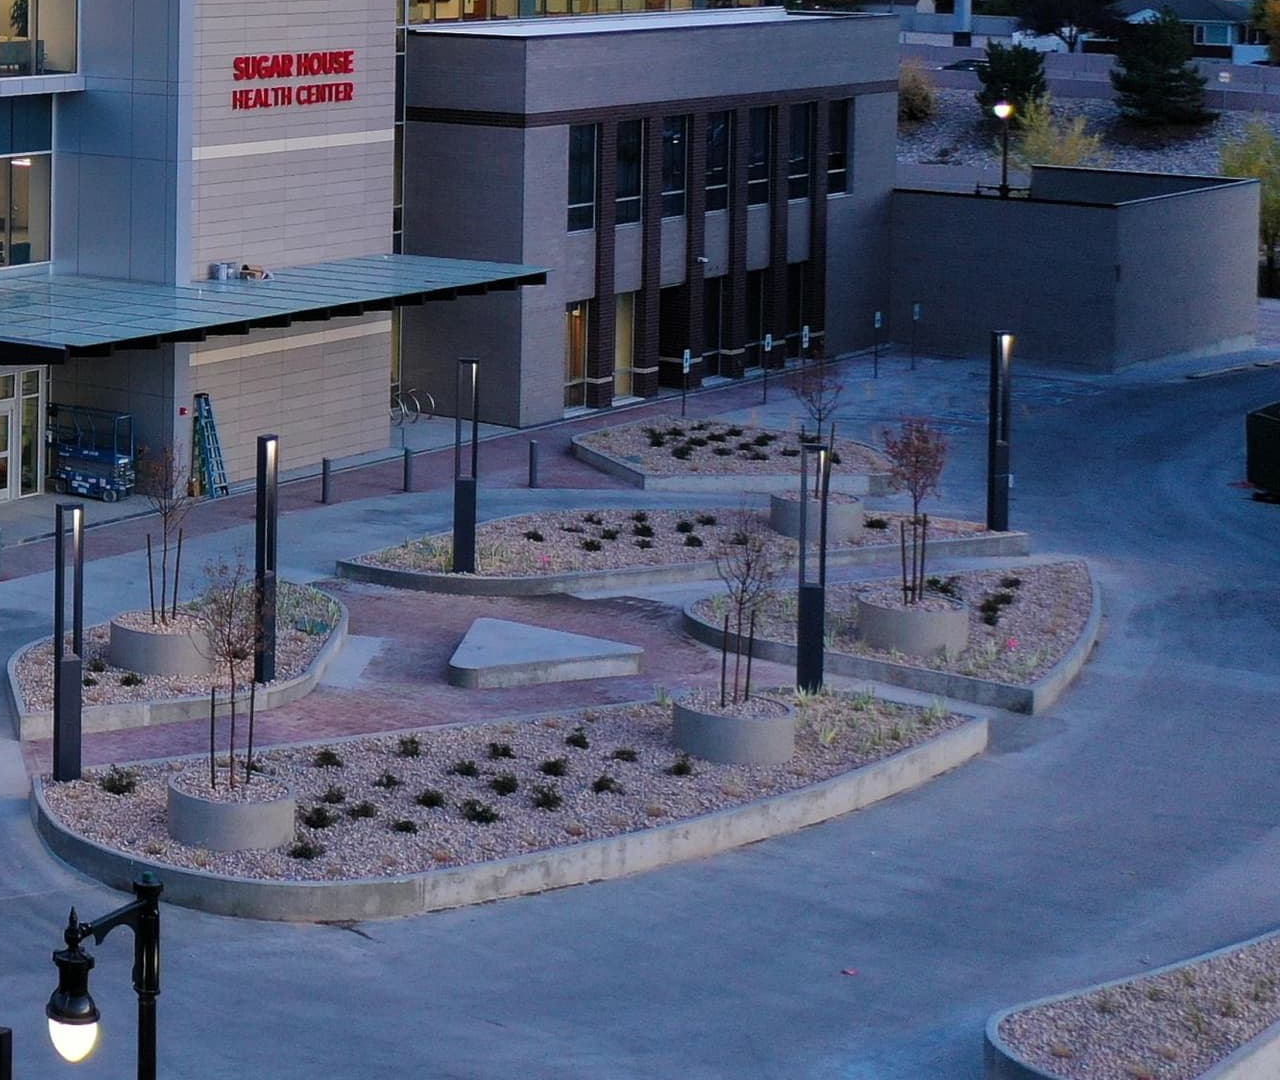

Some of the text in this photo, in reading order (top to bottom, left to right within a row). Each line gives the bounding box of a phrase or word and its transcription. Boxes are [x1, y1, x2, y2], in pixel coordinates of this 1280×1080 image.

[233, 50, 354, 81] SUGAR HOUSE
[232, 82, 354, 110] HEALTH CENTER
